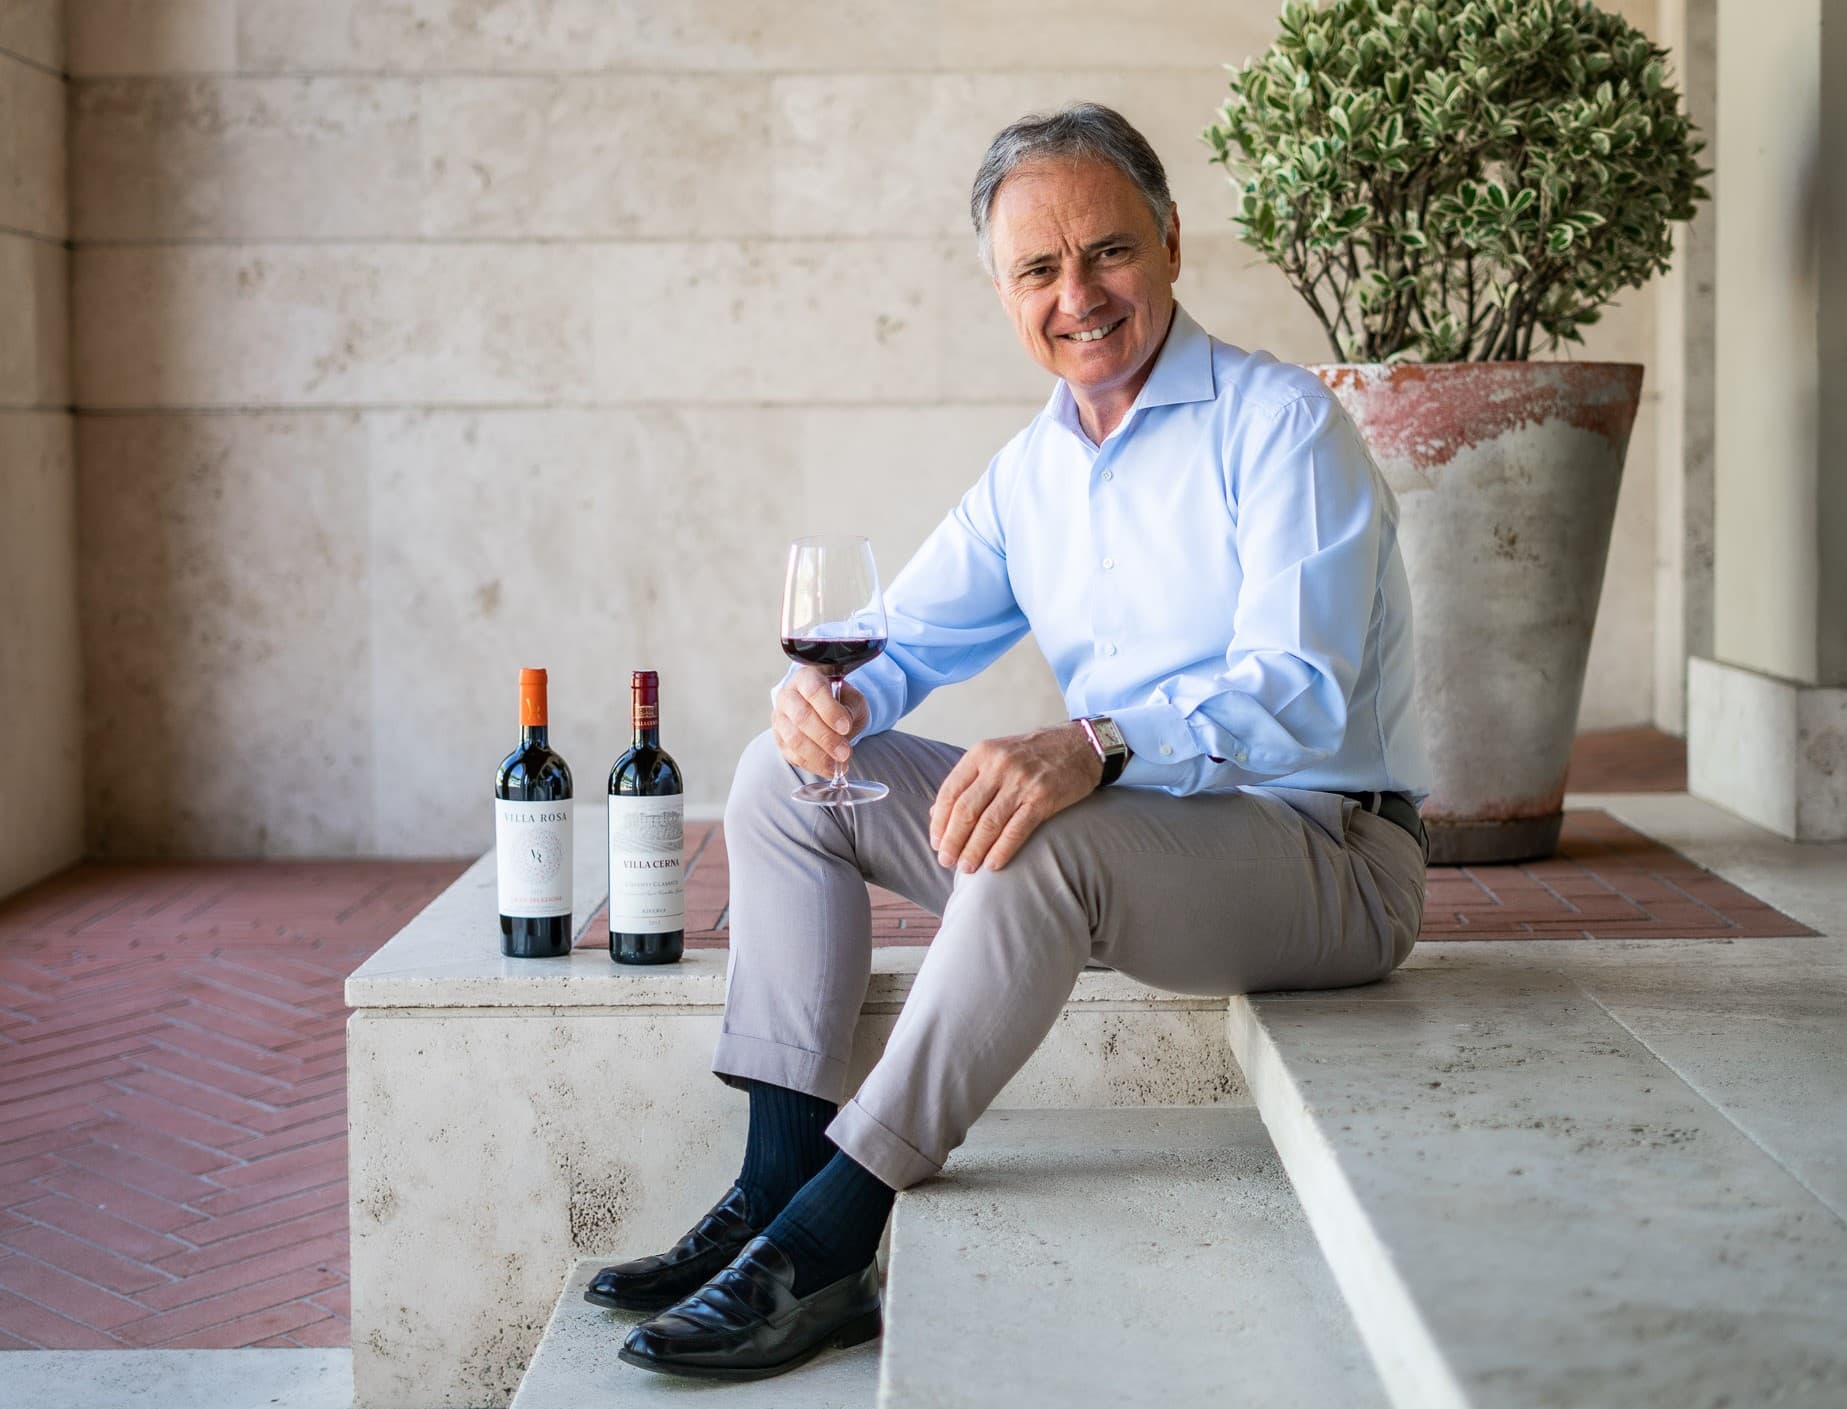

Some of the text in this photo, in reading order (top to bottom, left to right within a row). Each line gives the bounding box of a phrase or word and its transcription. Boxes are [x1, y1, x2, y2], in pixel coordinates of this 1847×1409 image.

[505, 812, 567, 823] VILLA ROSA
[623, 860, 651, 869] VILLA
